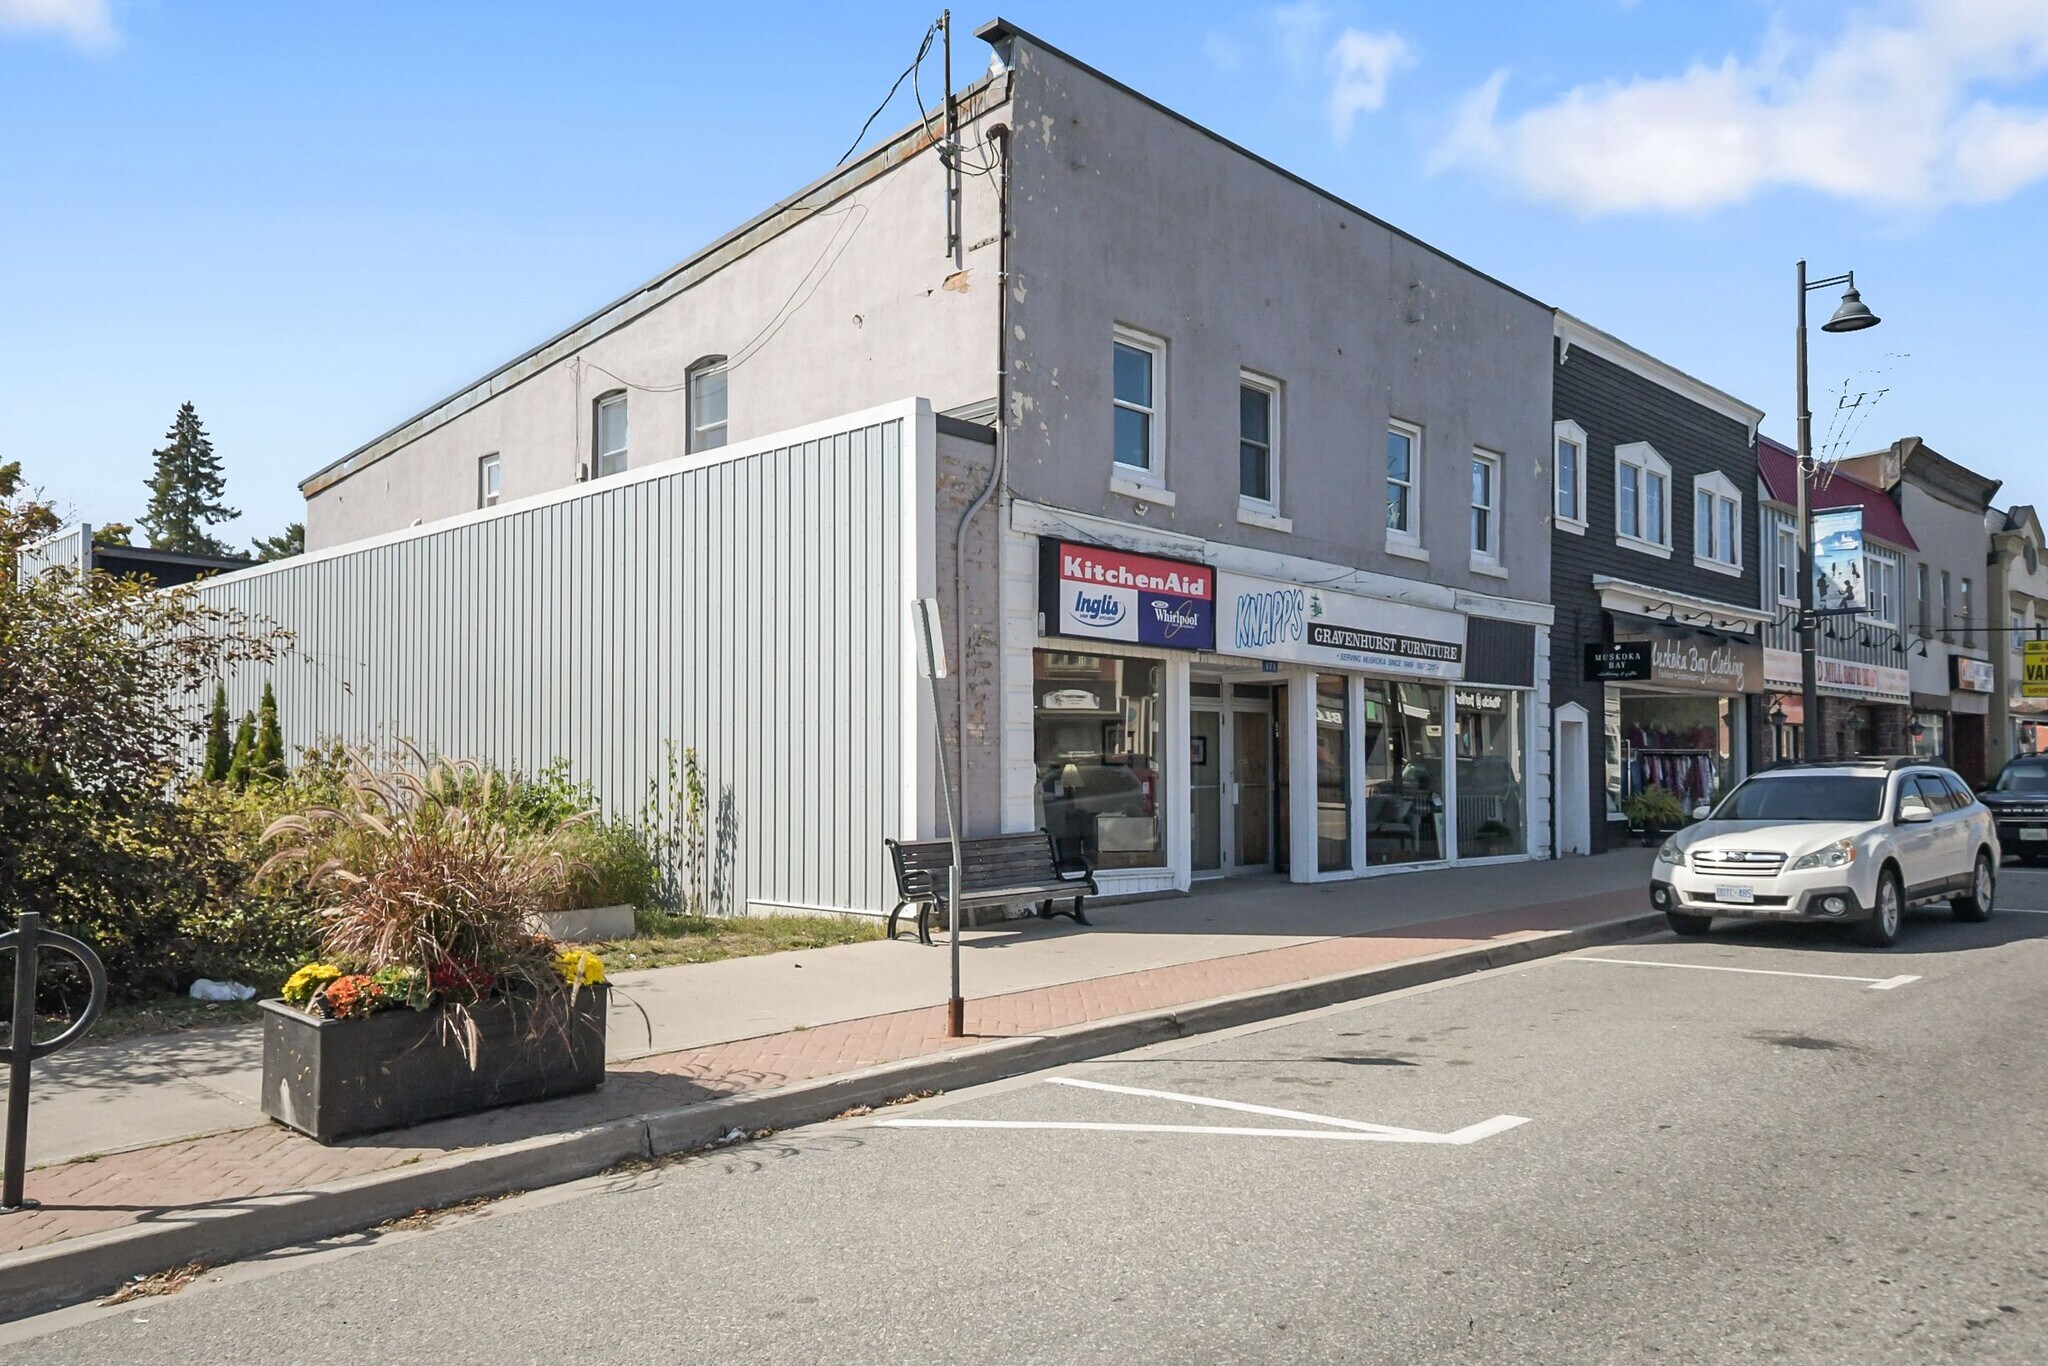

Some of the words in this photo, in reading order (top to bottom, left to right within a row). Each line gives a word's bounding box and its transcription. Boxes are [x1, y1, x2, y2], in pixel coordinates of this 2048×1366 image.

[1063, 555, 1204, 596] KitchenAid
[1075, 591, 1118, 619] Inglis
[1154, 608, 1198, 628] Whirlpool
[1235, 588, 1304, 648] KNAPP'S
[1314, 627, 1397, 652] GRAVENHURST
[1400, 640, 1458, 660] FURNITURE
[1340, 653, 1361, 662] SERVING
[1363, 656, 1386, 665] MUSKOKA
[1594, 653, 1641, 661] MUSKOKA
[1608, 661, 1626, 669] BAY
[1689, 645, 1709, 684] Bay
[1710, 647, 1745, 691] Clothing
[2026, 664, 2048, 681] VA
